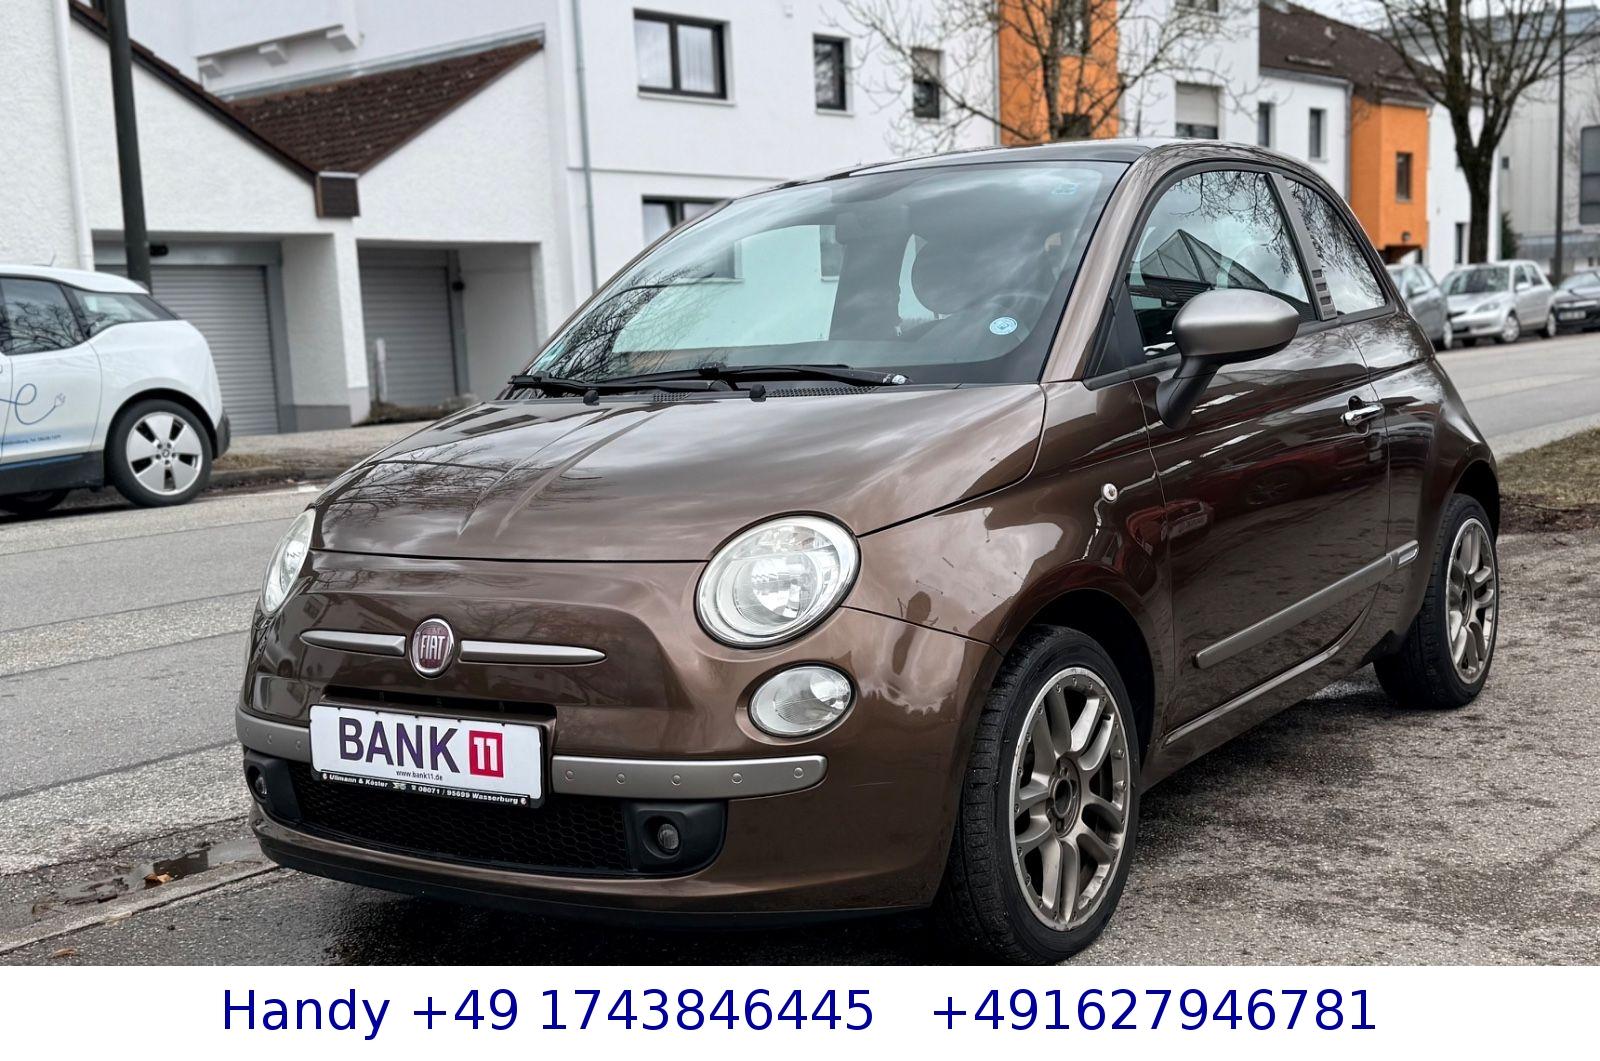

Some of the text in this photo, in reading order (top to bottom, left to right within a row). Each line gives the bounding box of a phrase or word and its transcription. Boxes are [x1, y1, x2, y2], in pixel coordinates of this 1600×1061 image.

[420, 634, 446, 660] FIAT
[338, 716, 499, 774] BANK 11
[395, 770, 443, 781] www.bank11.de
[417, 784, 440, 795] 08071
[472, 792, 519, 805] Wasserburg
